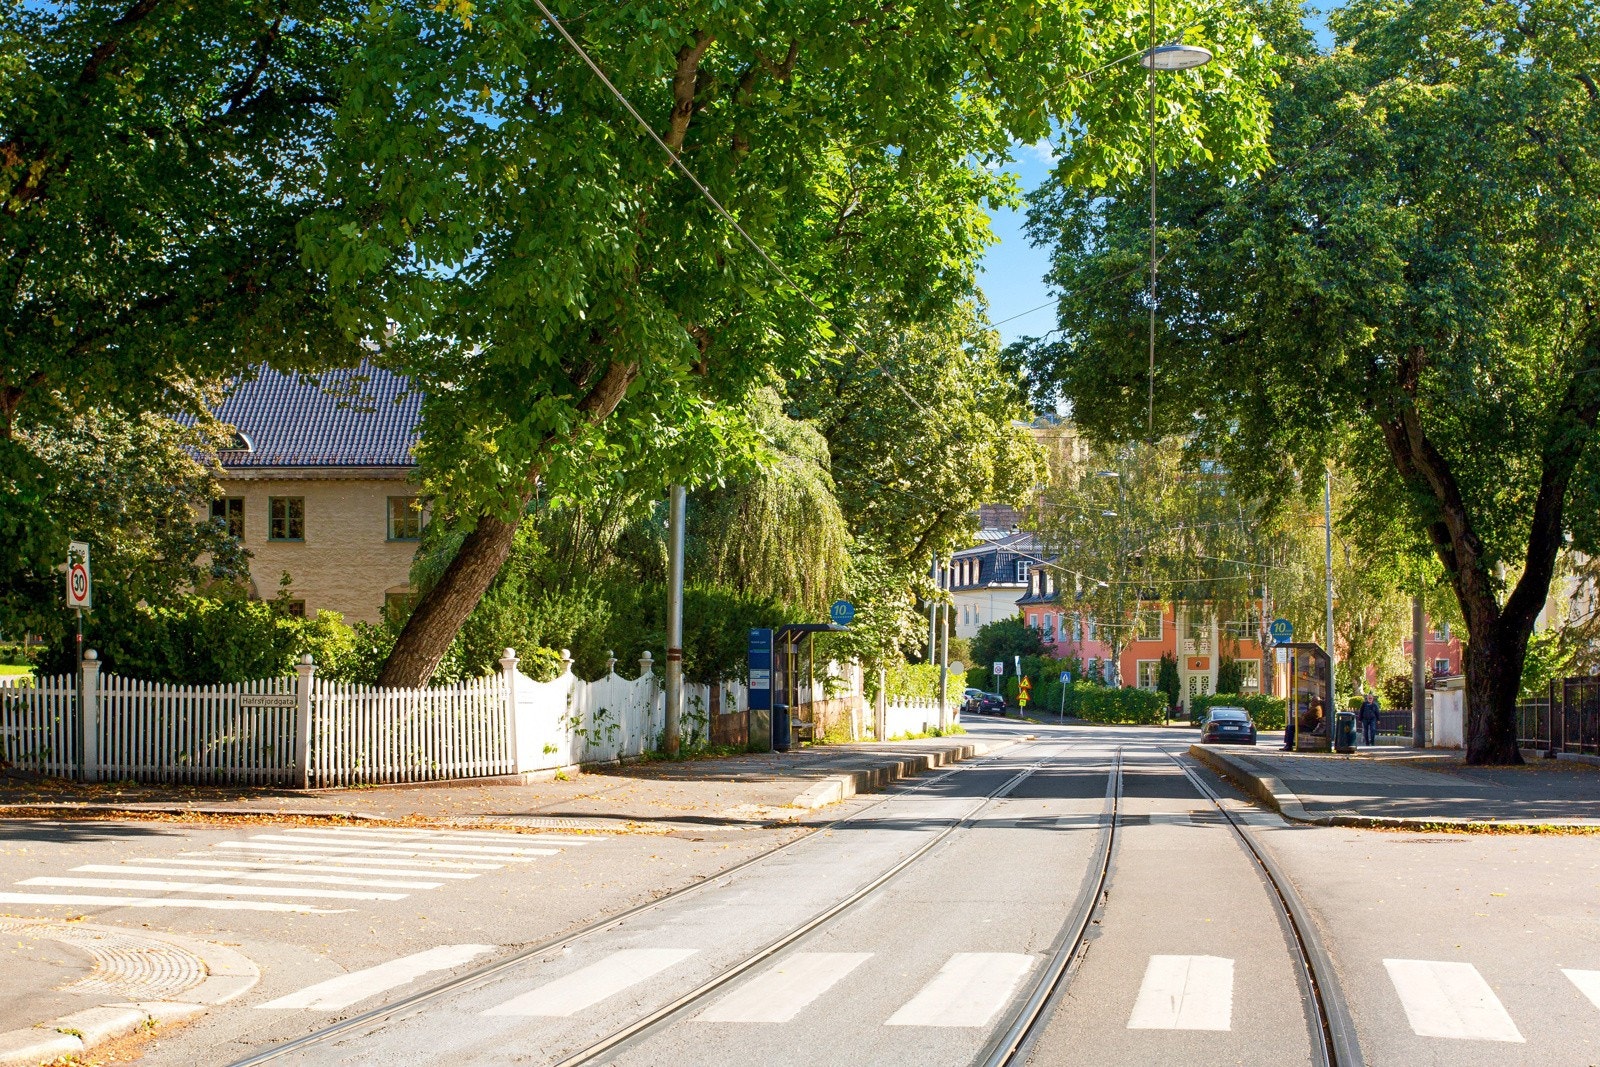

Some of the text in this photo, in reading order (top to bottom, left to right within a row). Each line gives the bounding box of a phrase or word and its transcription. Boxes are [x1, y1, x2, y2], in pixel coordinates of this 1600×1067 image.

[74, 573, 85, 592] 30
[834, 604, 847, 616] 10
[1274, 622, 1287, 633] 10
[242, 697, 294, 706] Hafrsfjordgata
